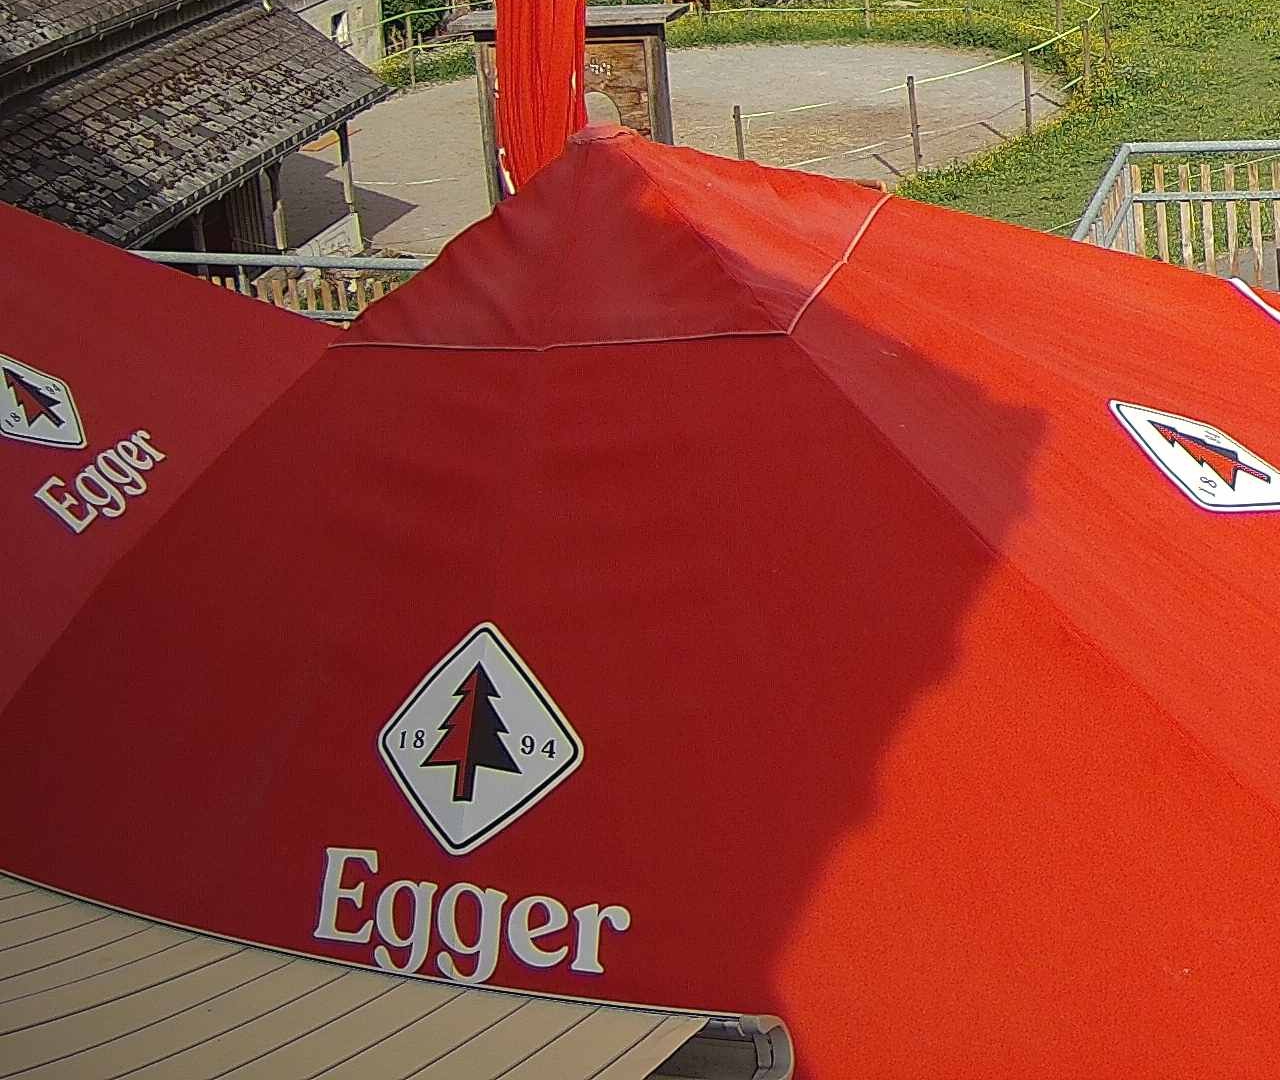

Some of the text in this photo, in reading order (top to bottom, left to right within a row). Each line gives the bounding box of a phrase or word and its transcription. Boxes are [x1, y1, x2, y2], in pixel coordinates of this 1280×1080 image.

[33, 429, 167, 534] Egger
[399, 729, 557, 759] 18 94
[313, 846, 632, 984] Egger
